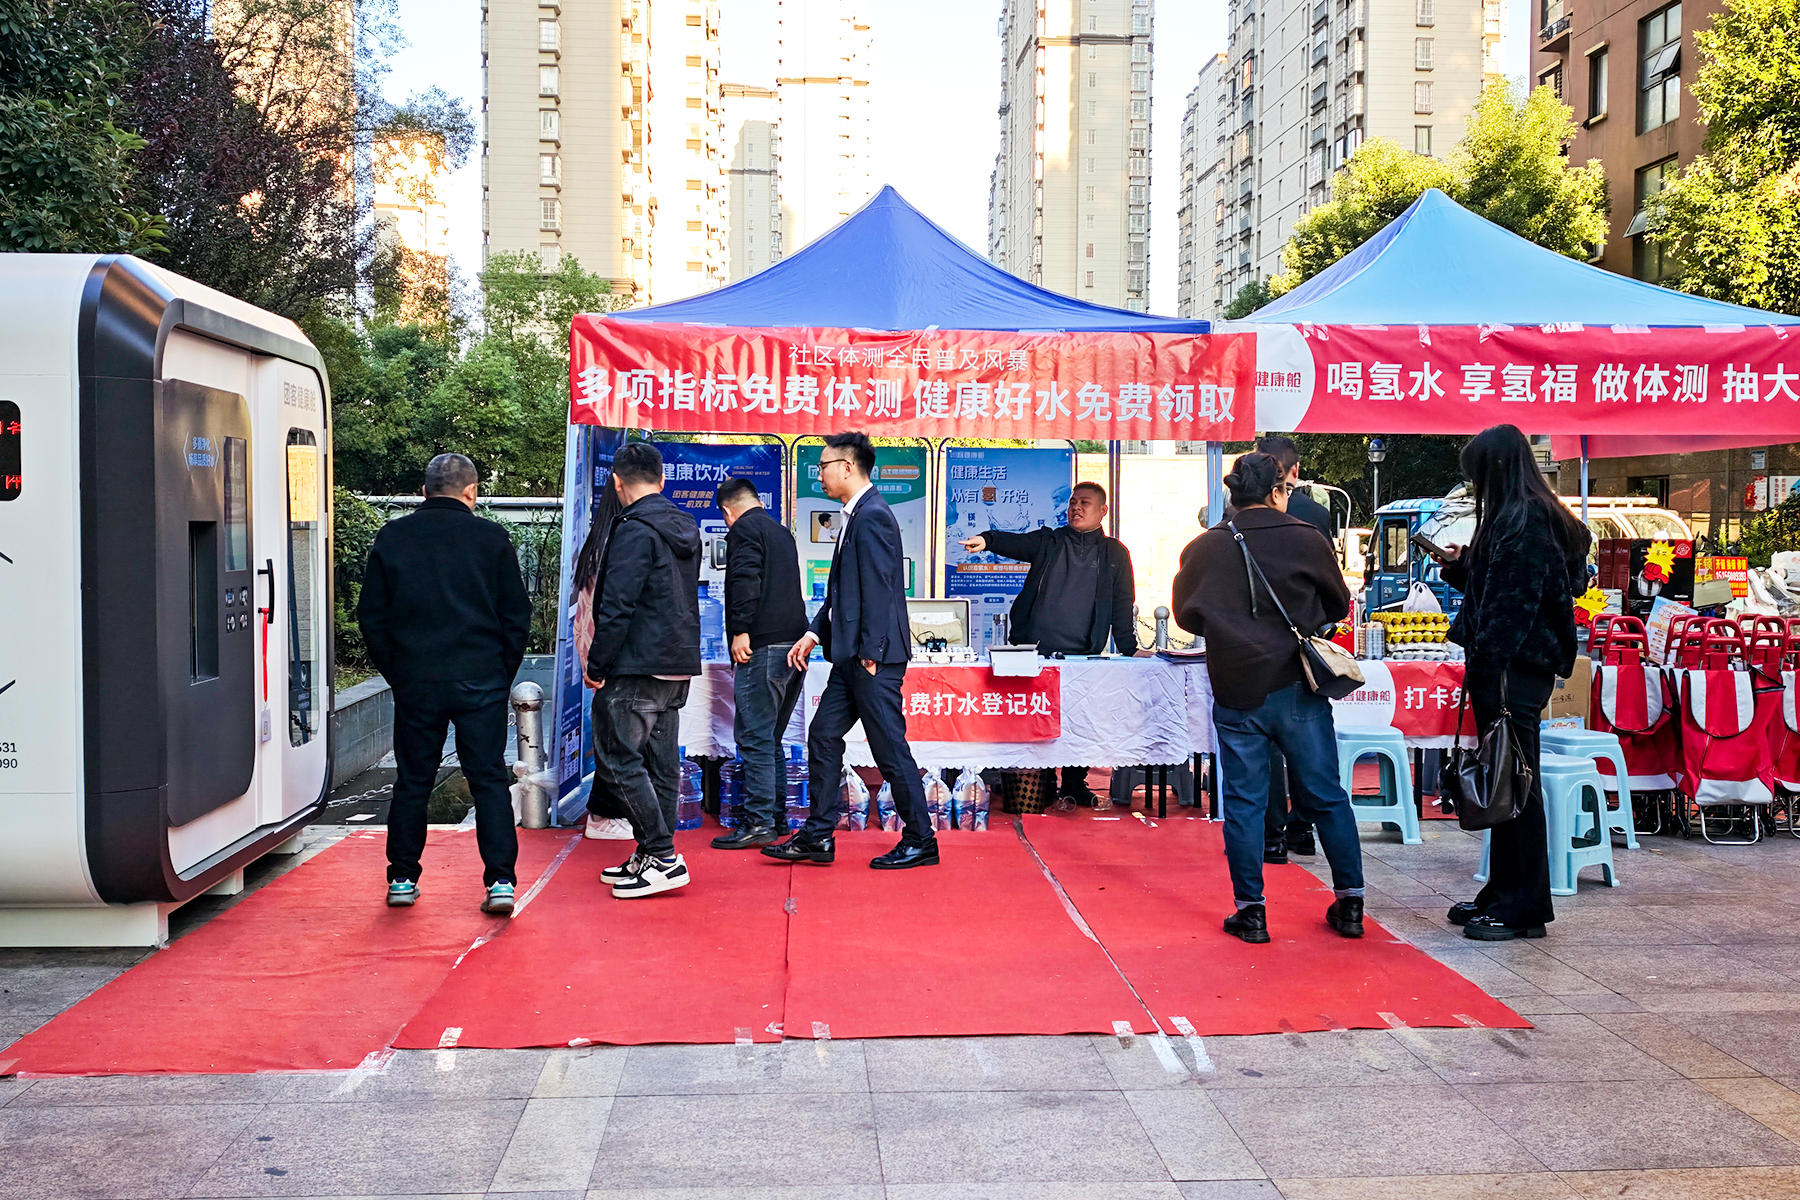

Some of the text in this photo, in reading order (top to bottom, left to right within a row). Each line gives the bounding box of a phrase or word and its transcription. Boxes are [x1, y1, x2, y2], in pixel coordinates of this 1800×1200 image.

[788, 343, 1029, 372] 社区体测全民普及风暴
[575, 366, 1236, 425] 多项指标免费体测 健康好水免费领取
[1326, 361, 1800, 404] 喝氢水 享氢福 做体测 抽大
[950, 464, 1008, 481] 健康生活
[902, 691, 1053, 717] 费打水登记处
[1332, 690, 1391, 701] 客健康舱
